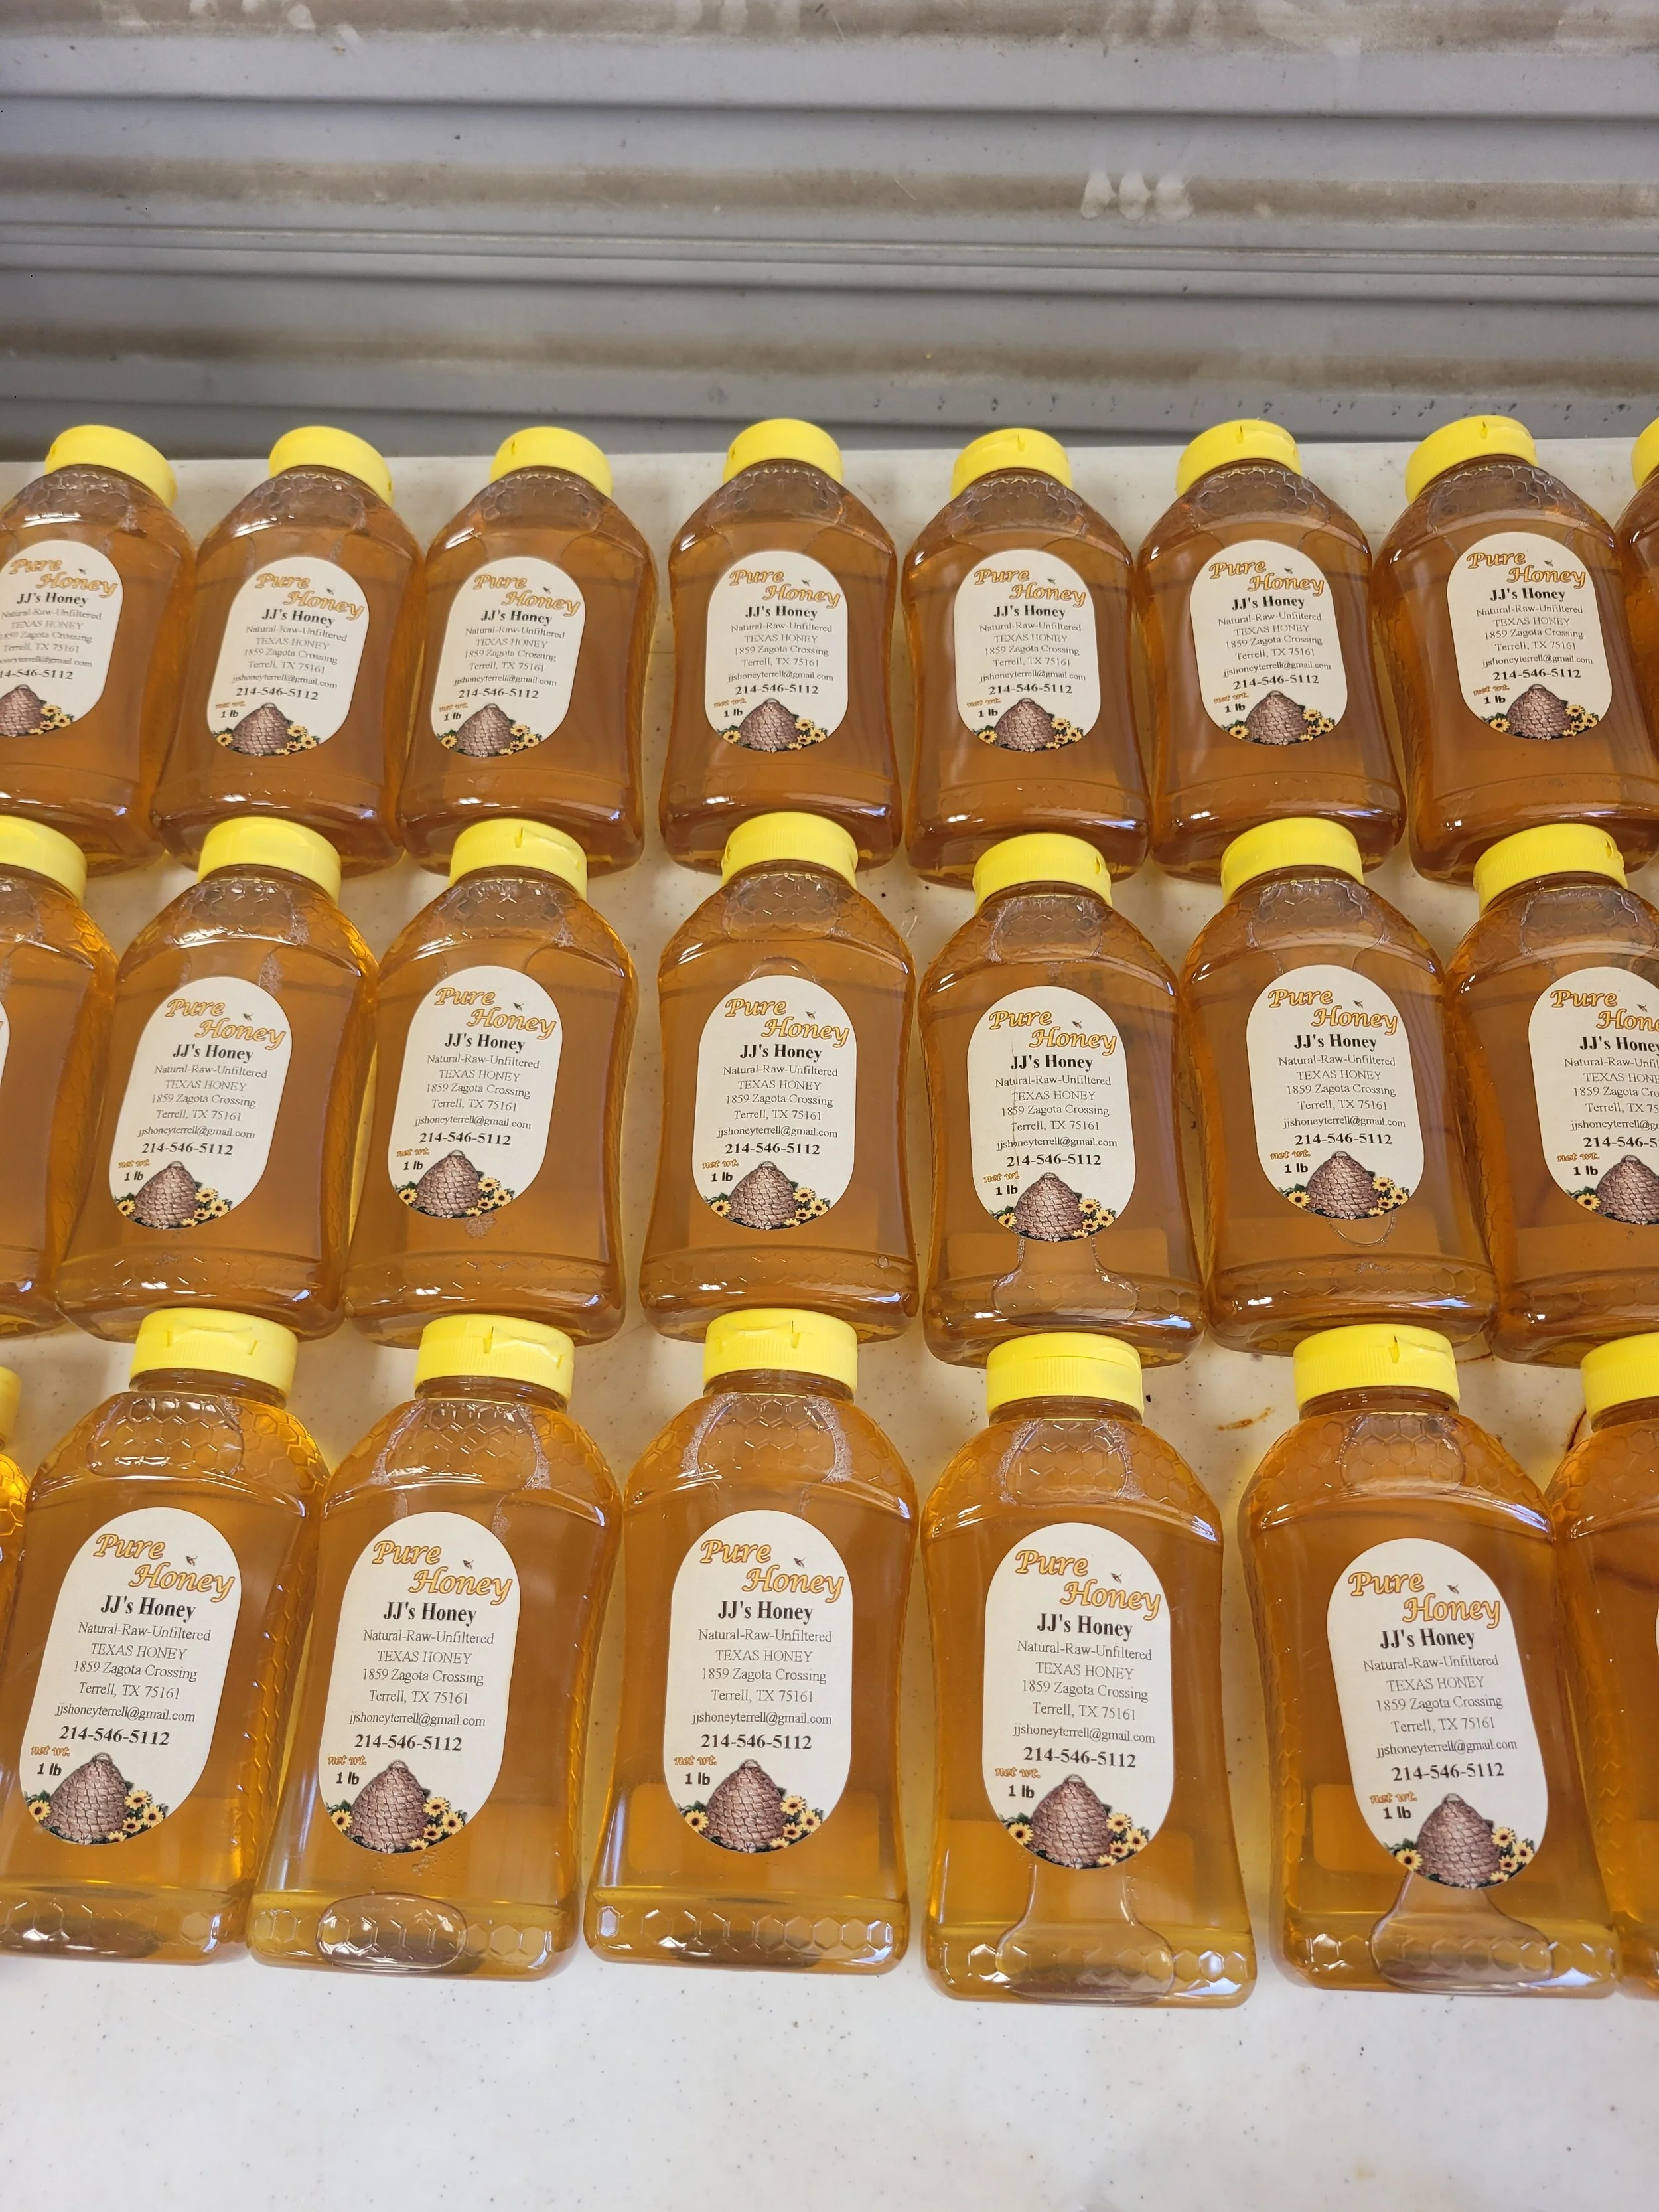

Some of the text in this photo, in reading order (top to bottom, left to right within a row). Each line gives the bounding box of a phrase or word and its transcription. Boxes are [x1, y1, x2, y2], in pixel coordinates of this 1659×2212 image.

[9, 558, 62, 574] Pure
[1466, 552, 1526, 569] Pure
[729, 569, 784, 586] Pure
[974, 567, 1030, 585] Pure
[1208, 561, 1267, 579] Pure
[1506, 565, 1586, 591] Honey
[35, 571, 117, 599] Honey
[255, 573, 311, 589] Pure
[472, 574, 528, 590] Pure
[1247, 572, 1324, 597] Honey
[17, 592, 86, 607] JJ's Honey
[500, 589, 581, 617] Honey
[762, 583, 841, 609] Honey
[1009, 581, 1086, 608] Honey
[1490, 587, 1565, 602] JJ's Honey
[283, 590, 364, 621] Honey
[1232, 596, 1305, 611] JJ's Honey
[1476, 604, 1583, 617] Natural-Raw-Unfiltered
[261, 609, 334, 626] JJ's Honey
[480, 609, 552, 625] JJ's Honey
[745, 605, 818, 621] JJ's Honey
[993, 605, 1066, 620] JJ's Honey
[731, 621, 832, 632] Natural-Raw-Unfiltered
[1492, 616, 1570, 627] TEXAS HONEY
[1233, 674, 1319, 690] 214-546-5112
[1492, 668, 1581, 681] 214-546-5112
[236, 687, 319, 700] 214-546-5112
[458, 688, 539, 699] 214-546-5112
[735, 684, 818, 695] 214-546-5112
[988, 683, 1072, 695] 214-546-5112
[433, 986, 496, 1006] Pure
[1267, 988, 1334, 1008] Pure
[1550, 990, 1618, 1008] Pure
[165, 997, 226, 1017] Pure
[724, 998, 787, 1017] Pure
[466, 1007, 557, 1040] Honey
[988, 1010, 1052, 1030] Pure
[1311, 1005, 1398, 1040] Honey
[194, 1017, 287, 1051] Honey
[760, 1016, 850, 1048] Honey
[445, 1033, 526, 1054] JJ's Honey
[1028, 1026, 1117, 1057] Honey
[1294, 1033, 1376, 1052] JJ's Honey
[1579, 1035, 1611, 1050] JJ's
[173, 1043, 254, 1064] JJ's Honey
[740, 1044, 822, 1063] JJ's Honey
[1011, 1054, 1093, 1072] JJ's Honey
[165, 1080, 248, 1092] TEXAS HONEY
[432, 1098, 516, 1112] Terrell, TX 75161
[727, 1093, 833, 1108] 1859 Zagota Crossing
[1297, 1099, 1387, 1110] Terrell, TX 75161
[419, 1132, 511, 1145] 214-546-5112
[1294, 1132, 1392, 1145] 214-546-5112
[141, 1142, 233, 1155] 214-546-5112
[725, 1142, 820, 1155] 214-546-5112
[403, 1160, 423, 1171] 1 lb
[1006, 1153, 1101, 1167] 214-546-5112
[1285, 1163, 1308, 1173] 1 lb
[711, 1171, 733, 1182] 1 lb
[1573, 1165, 1598, 1176] 1 lb
[995, 1185, 1018, 1196] 1 lb
[92, 1532, 166, 1560] Pure
[371, 1539, 442, 1566] Pure
[699, 1538, 772, 1564] Pure
[1014, 1549, 1088, 1578] Pure
[127, 1561, 236, 1603] Honey
[407, 1566, 513, 1606] Honey
[741, 1564, 845, 1604] Honey
[1348, 1570, 1425, 1597] Pure
[1059, 1578, 1161, 1621] Honey
[100, 1595, 196, 1623] JJ's Honey
[383, 1601, 477, 1627] JJ's Honey
[718, 1600, 813, 1625] JJ's Honey
[1402, 1592, 1500, 1629] Honey
[78, 1622, 211, 1641] Natural-Raw-Unfiltered
[698, 1628, 831, 1643] Natural-Raw-Unfiltered
[1037, 1613, 1133, 1642] JJ's Honey
[363, 1629, 494, 1645] Natural-Raw-Unfiltered
[1380, 1628, 1474, 1650] JJ's Honey
[91, 1643, 188, 1660] TEXAS HONEY
[378, 1650, 472, 1664] TEXAS HONEY
[715, 1649, 813, 1662] TEXAS HONEY
[1017, 1640, 1152, 1660] Natural-Raw-Unfiltered
[1035, 1662, 1135, 1680] TEXAS HONEY
[1363, 1654, 1499, 1672] Natural-Raw-Unfiltered
[703, 1668, 826, 1685] 1859 Zagota Crossing
[1386, 1676, 1484, 1692] TEXAS HONEY
[80, 1682, 179, 1700] Terrell, TX 75161
[711, 1689, 812, 1704] Terrell, TX 75161
[54, 1703, 195, 1722] jjshoneyterrell@gmail.com
[348, 1711, 485, 1727] jjshoneyterrell@gmail.com
[691, 1711, 831, 1726] jjshoneyterrell@gmail.com
[59, 1726, 170, 1745] 214-546-5112
[701, 1733, 812, 1749] 214-546-5112
[1012, 1724, 1155, 1743] jjshoneyterrell@gmail.com
[354, 1734, 462, 1751] 214-546-5112
[1376, 1739, 1518, 1759] jjshoneyterrell@gmail.com
[1023, 1747, 1136, 1768] 214-546-5112
[37, 1763, 62, 1776] 1 lb
[336, 1771, 360, 1785] 1 lb
[1391, 1762, 1504, 1781] 214-546-5112
[685, 1772, 710, 1785] 1 lb
[1008, 1784, 1035, 1799] 1 lb
[1383, 1806, 1411, 1819] 1 lb
